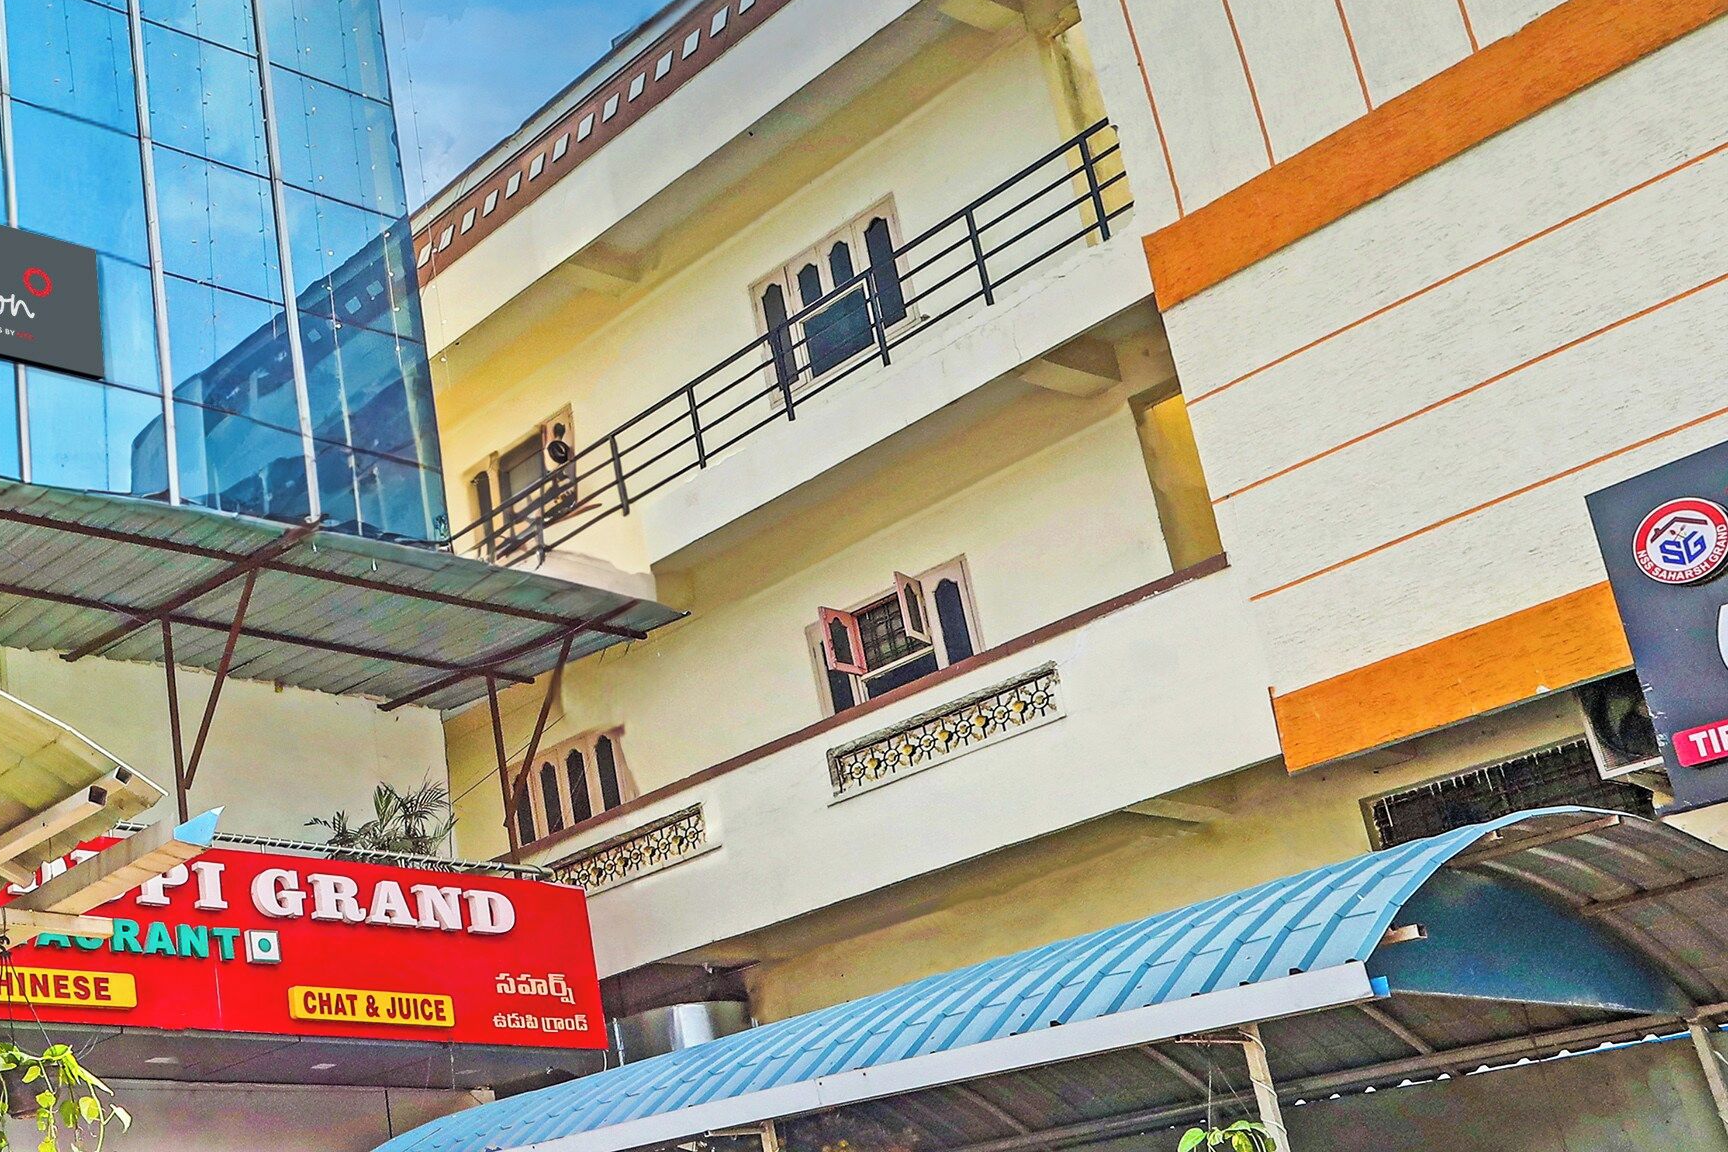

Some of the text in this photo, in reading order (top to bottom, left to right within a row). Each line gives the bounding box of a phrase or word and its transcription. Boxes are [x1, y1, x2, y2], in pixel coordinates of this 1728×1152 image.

[5, 328, 15, 336] BY
[1637, 524, 1728, 580] NSS SAHARSH GRAND
[1659, 531, 1707, 565] SG
[251, 868, 516, 935] GRAND
[303, 991, 446, 1021] CHAT & JUICE
